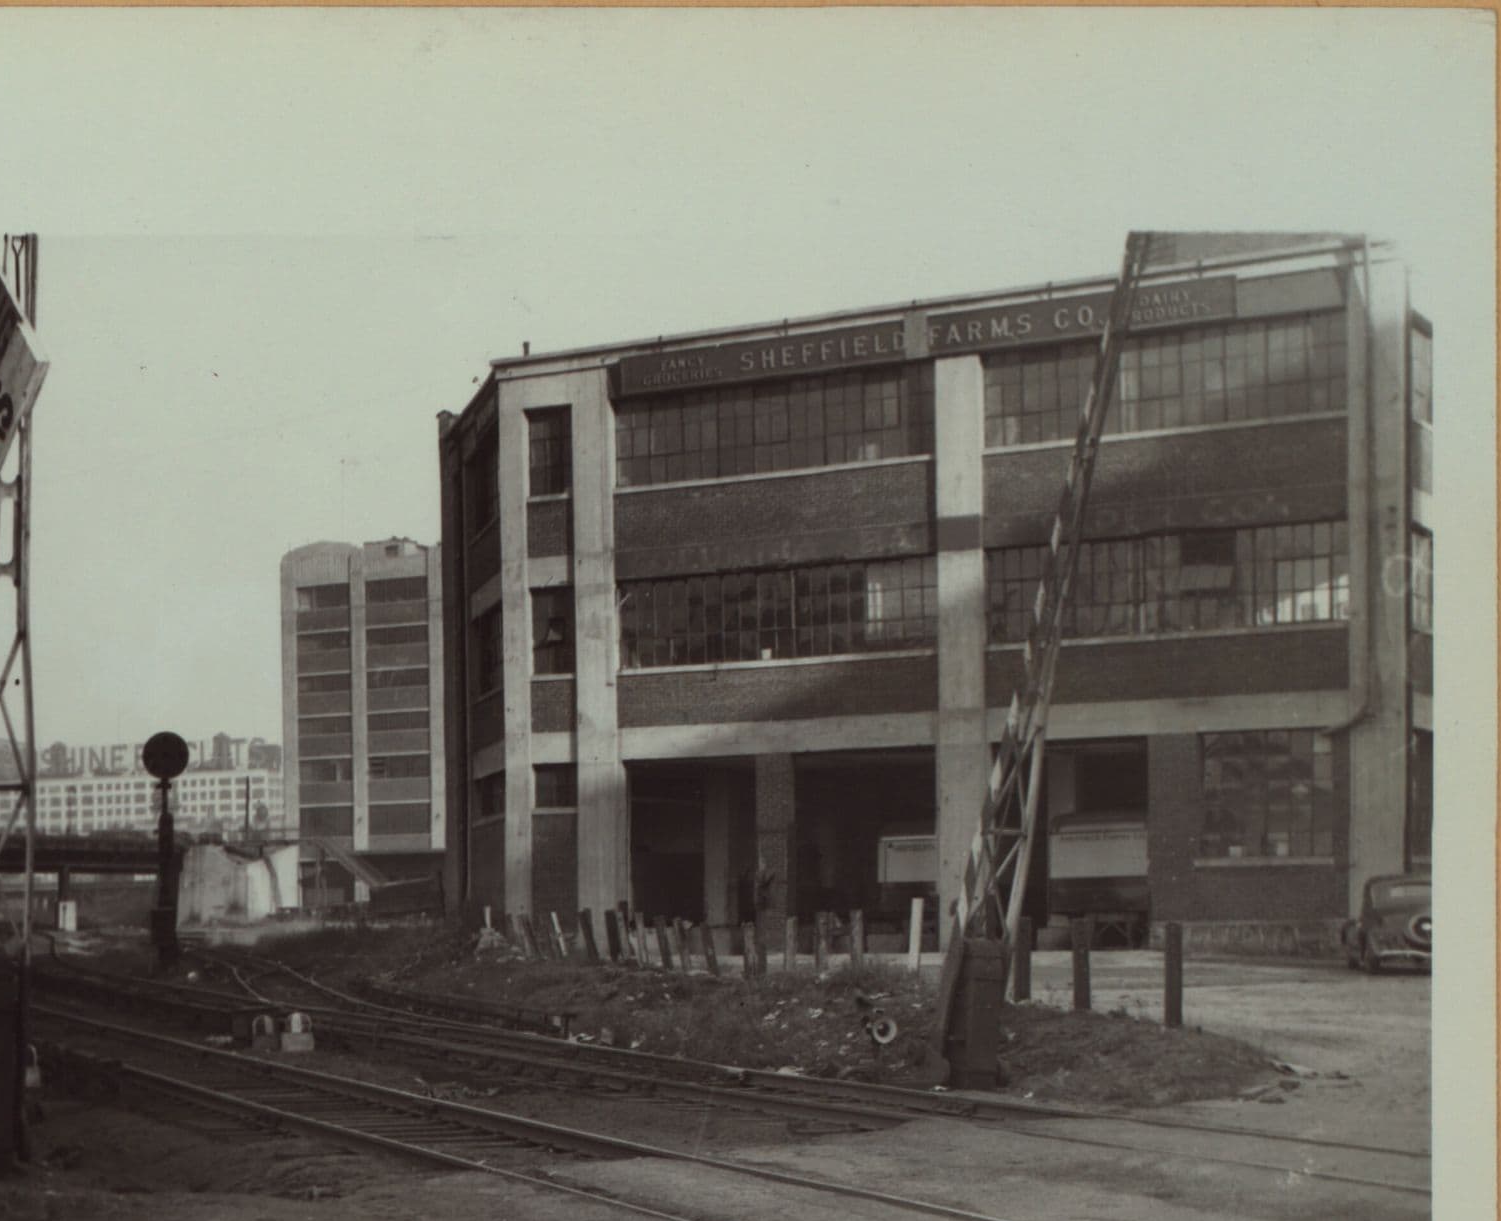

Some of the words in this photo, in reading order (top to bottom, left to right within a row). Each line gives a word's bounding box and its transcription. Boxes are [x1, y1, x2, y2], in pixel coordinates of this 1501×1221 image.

[1138, 286, 1191, 308] DAIRY
[1126, 301, 1213, 322] RODUCTS
[738, 329, 906, 373] SHEFFIELD
[928, 312, 1033, 347] FARMS
